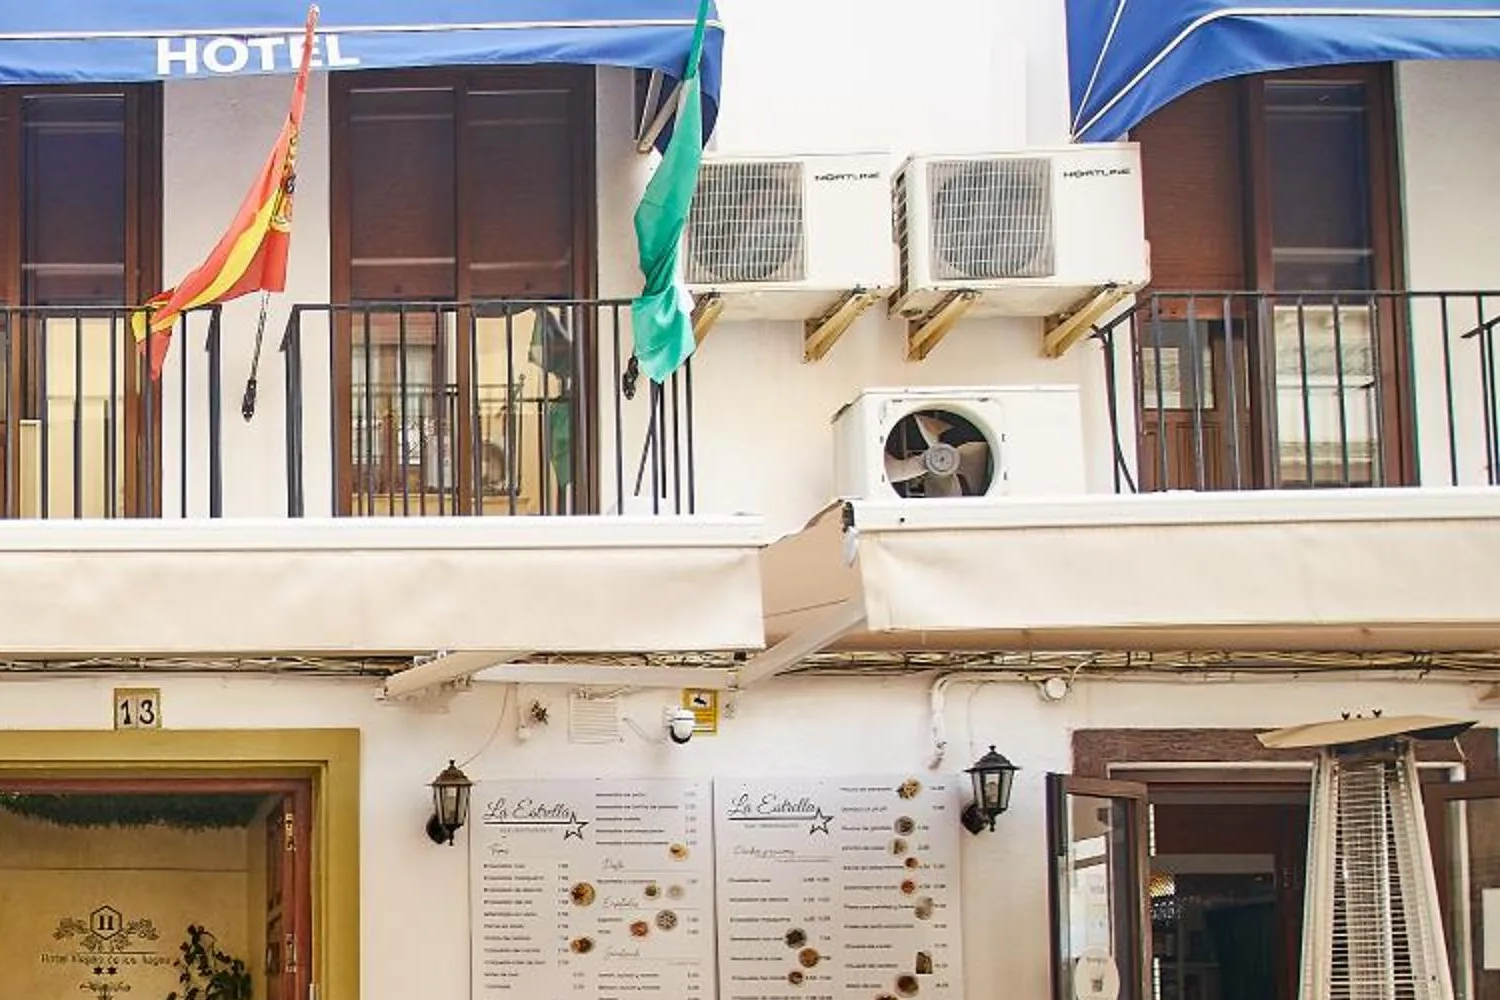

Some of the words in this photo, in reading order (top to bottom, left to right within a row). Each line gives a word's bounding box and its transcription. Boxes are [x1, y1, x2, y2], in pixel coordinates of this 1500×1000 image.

[156, 33, 361, 75] HOTEL
[120, 699, 155, 725] 13
[512, 799, 570, 819] Estrella
[757, 793, 815, 815] Estrella
